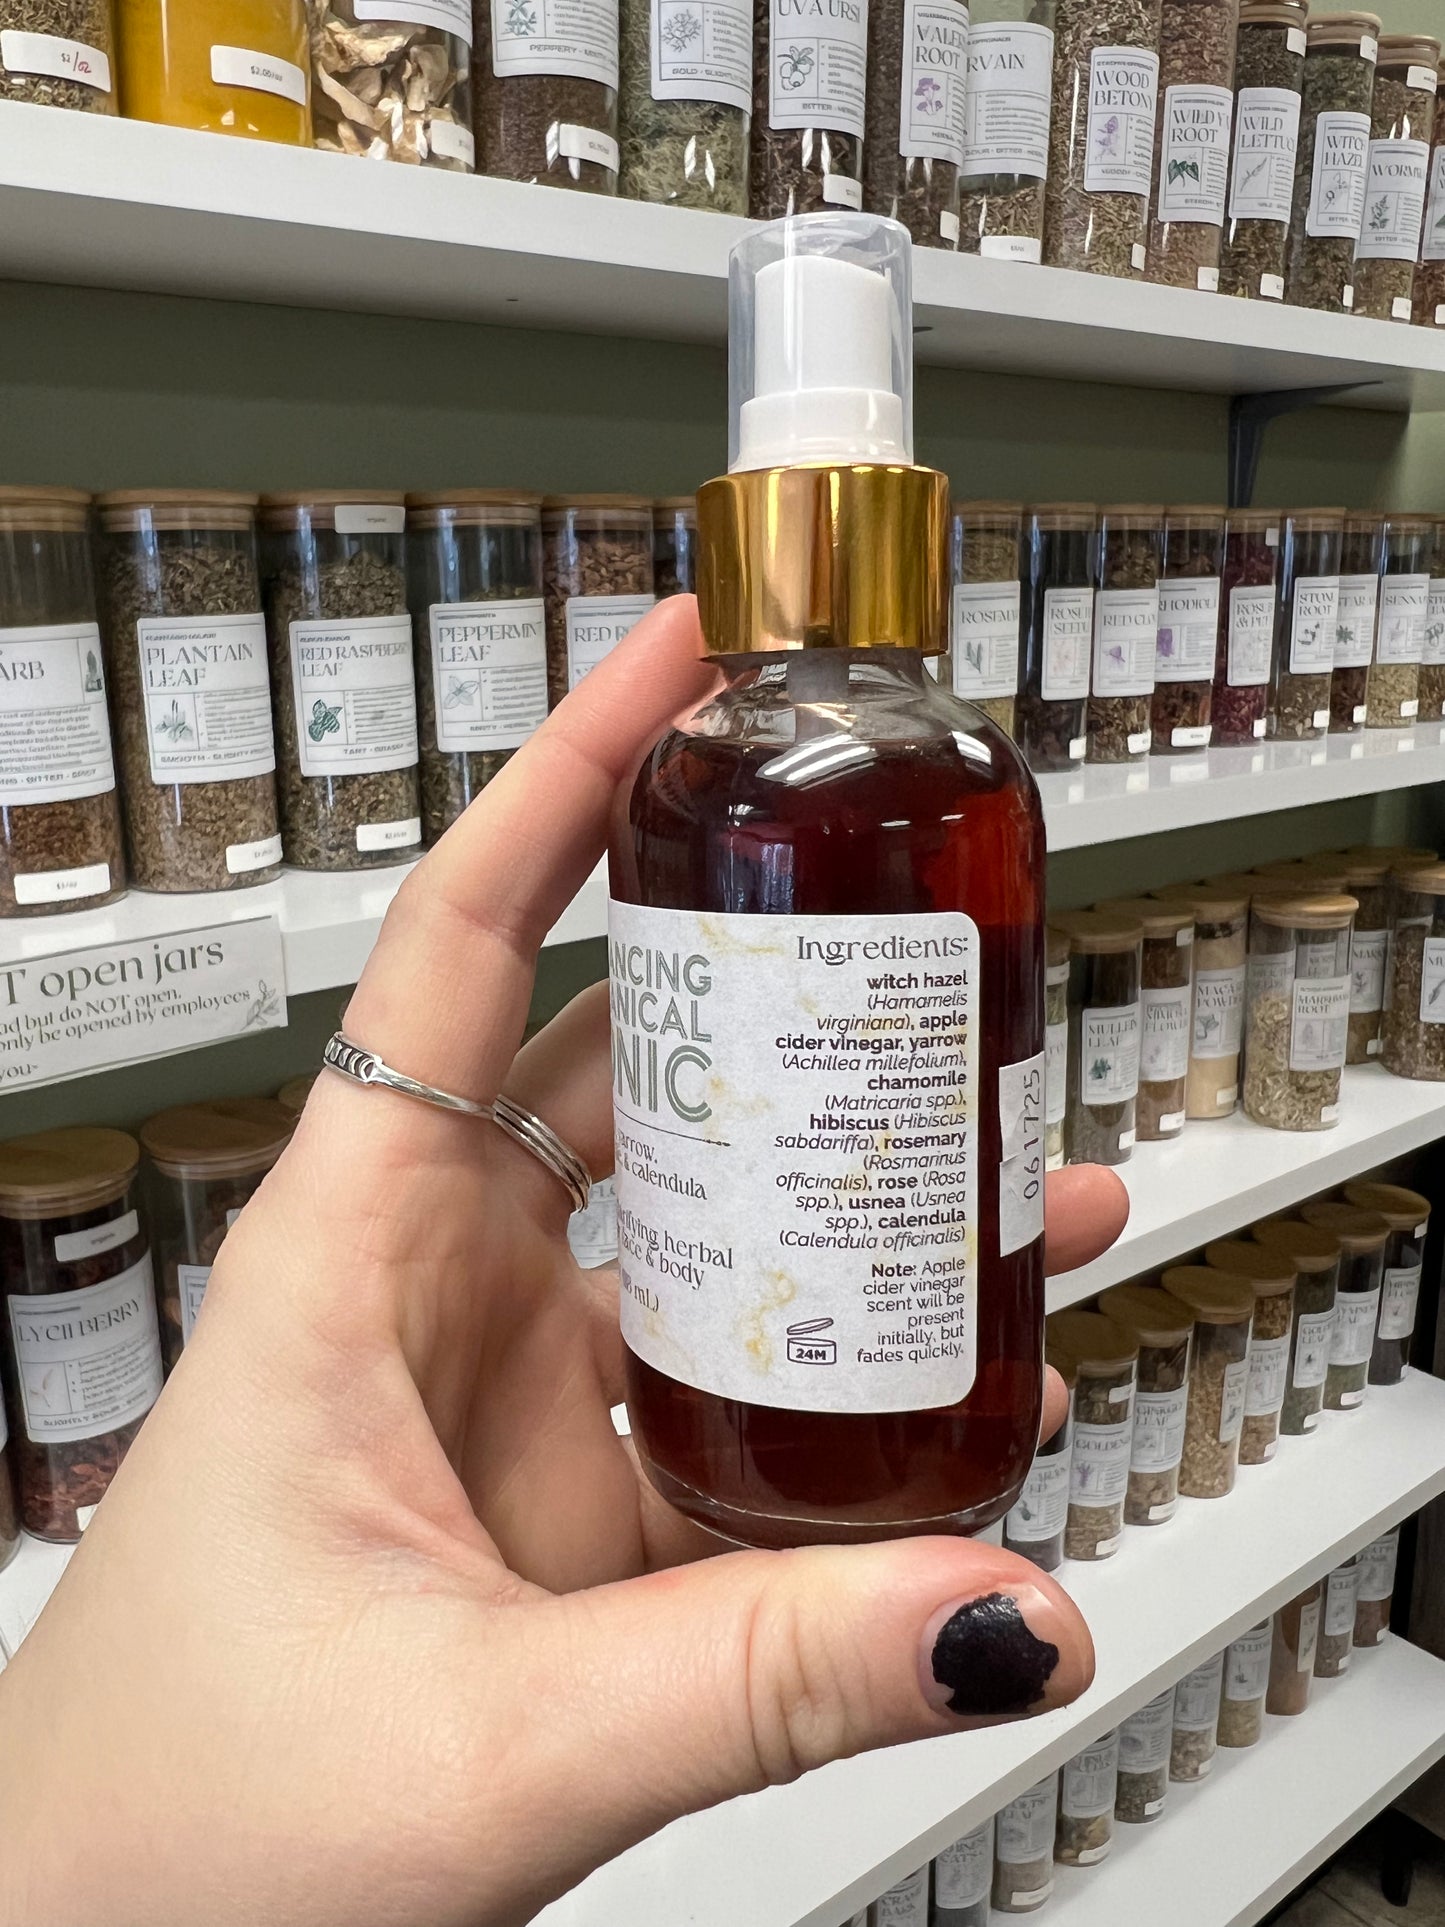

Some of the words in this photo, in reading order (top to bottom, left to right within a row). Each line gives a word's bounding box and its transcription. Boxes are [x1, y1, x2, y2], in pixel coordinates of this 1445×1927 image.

[916, 46, 960, 69] ROOT
[1096, 70, 1150, 89] WOOD
[1173, 109, 1214, 124] WILD
[1244, 116, 1283, 131] WILD
[1172, 127, 1218, 143] ROOT
[574, 627, 612, 642] RED
[147, 643, 253, 666] PLANTAIN
[301, 647, 332, 661] RED
[440, 645, 491, 663] LEAF
[149, 668, 206, 688] LEAF
[302, 662, 343, 677] LEAF
[797, 936, 969, 966] Ingredients:
[40, 956, 143, 1001] open
[153, 942, 225, 984] jars
[867, 973, 918, 989] witch
[923, 970, 968, 988] hazel
[25, 1010, 54, 1030] but
[59, 1005, 82, 1023] do
[85, 995, 131, 1018] NOT
[134, 989, 182, 1010] open.
[867, 990, 968, 1010] (Hamamelis
[40, 1025, 61, 1044] be
[65, 1013, 132, 1039] opened
[136, 1008, 157, 1026] by
[162, 990, 251, 1018] employees
[817, 1013, 915, 1034] virginiana),
[919, 1010, 968, 1031] apple
[775, 1033, 825, 1050] cider
[828, 1034, 904, 1054] vinegar,
[909, 1033, 967, 1053] yarrow
[782, 1053, 861, 1071] (Achillea
[612, 1025, 713, 1123] NIC
[867, 1071, 967, 1090] chamomile
[825, 1094, 922, 1111] (Matricaria
[809, 1114, 890, 1131] hibiscus
[894, 1112, 967, 1130] (Hibiscus
[774, 1133, 879, 1153] sabdariffa),
[884, 1131, 966, 1149] rosemary
[863, 1151, 966, 1171] (Rosmarinus
[632, 1162, 708, 1200] calendula
[776, 1172, 873, 1191] officinalis),
[877, 1176, 918, 1189] rose
[922, 1170, 966, 1187] (Rosa
[795, 1193, 843, 1212] spp.),
[848, 1196, 905, 1209] usnea
[911, 1190, 966, 1207] (Usnea
[825, 1214, 872, 1233] spp.),
[878, 1208, 966, 1229] calendula
[779, 1229, 878, 1249] (Calendula
[882, 1226, 966, 1251] officinalis)
[664, 1230, 733, 1269] herbal
[646, 1245, 655, 1268] &
[660, 1253, 704, 1290] body
[871, 1263, 916, 1278] Note:
[921, 1258, 966, 1277] Apple
[862, 1281, 905, 1295] cider
[910, 1274, 965, 1295] vinegar
[634, 1285, 659, 1312] mL)
[866, 1297, 912, 1313] scent
[916, 1294, 943, 1309] will
[946, 1291, 964, 1306] be
[79, 1296, 141, 1336] BERRY
[908, 1308, 964, 1330] present
[877, 1329, 937, 1345] initially,
[941, 1324, 964, 1340] but
[795, 1349, 827, 1361] 24M
[857, 1348, 904, 1363] fades
[908, 1343, 964, 1364] quickly.
